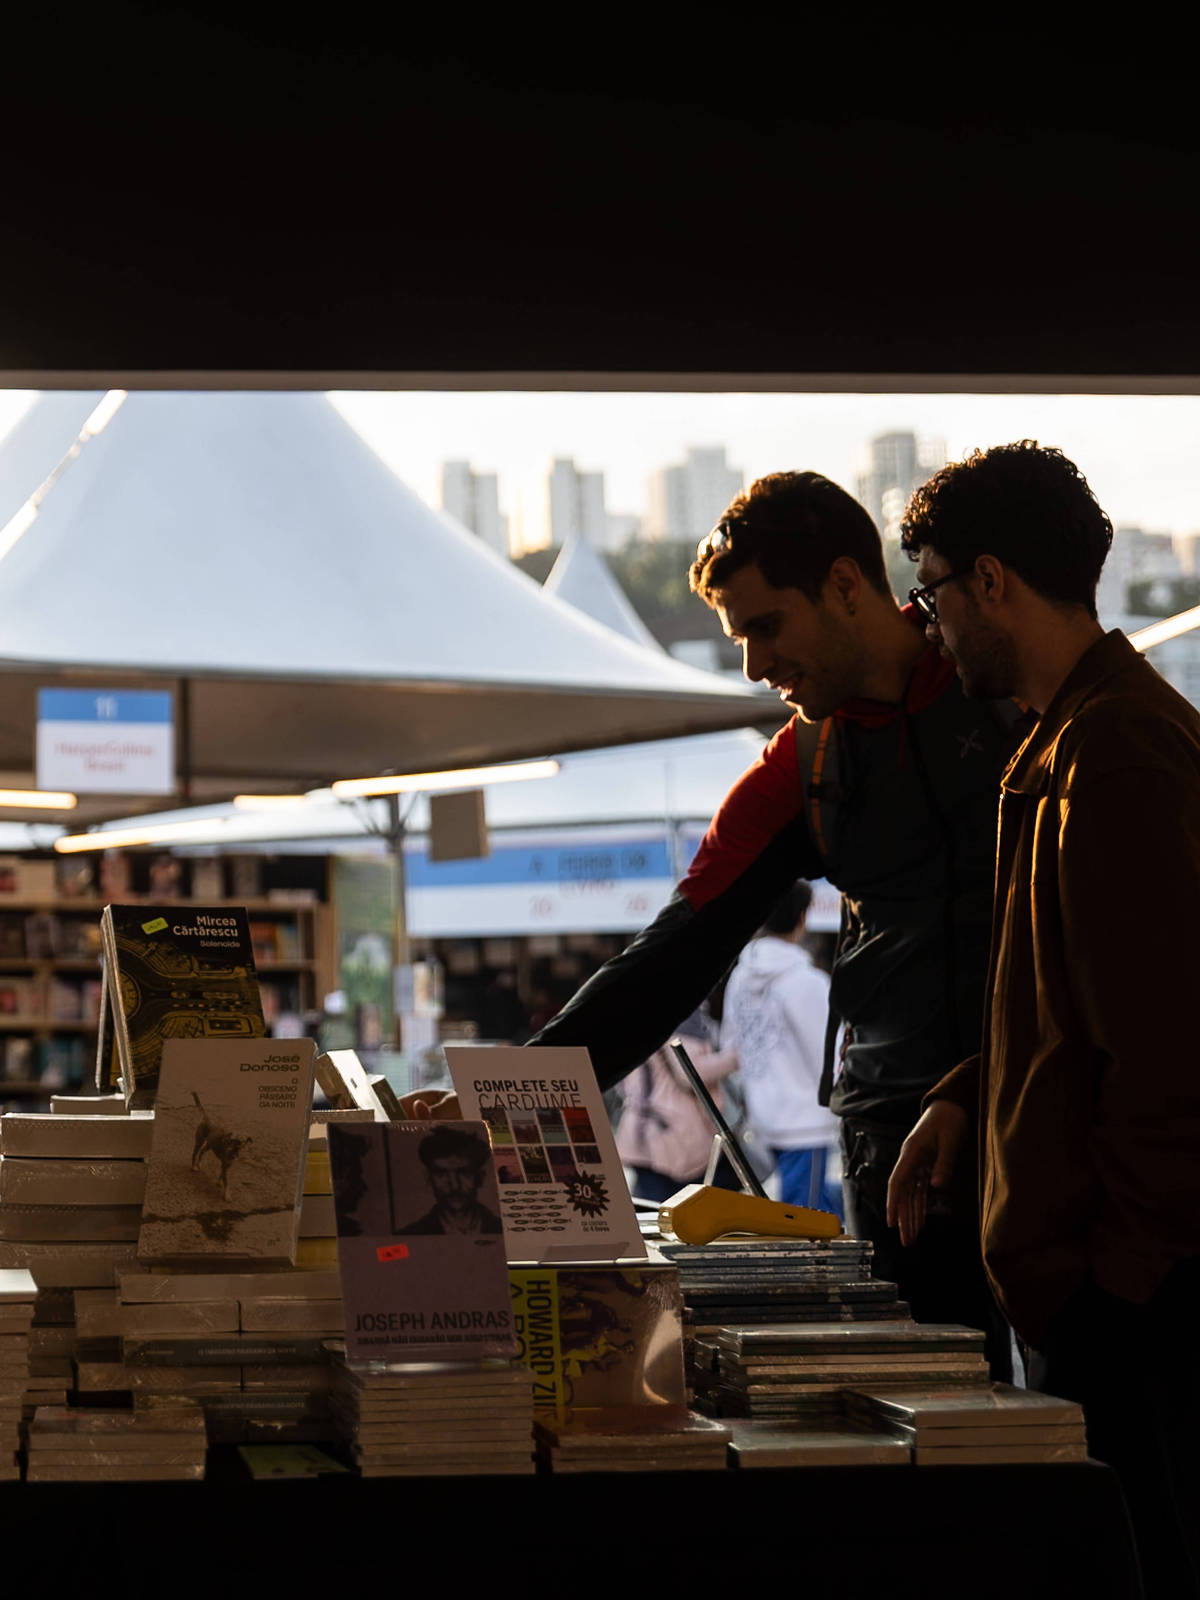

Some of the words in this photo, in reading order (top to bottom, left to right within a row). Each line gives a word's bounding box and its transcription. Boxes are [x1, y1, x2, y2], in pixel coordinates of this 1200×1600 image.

[196, 915, 237, 927] Mircea
[240, 1063, 300, 1072] Donoso
[473, 1080, 549, 1092] COMPLETE
[552, 1080, 579, 1092] SEU
[355, 1312, 425, 1332] JOSEPH
[431, 1310, 510, 1330] ANDRAS
[526, 1280, 554, 1375] HOWARD
